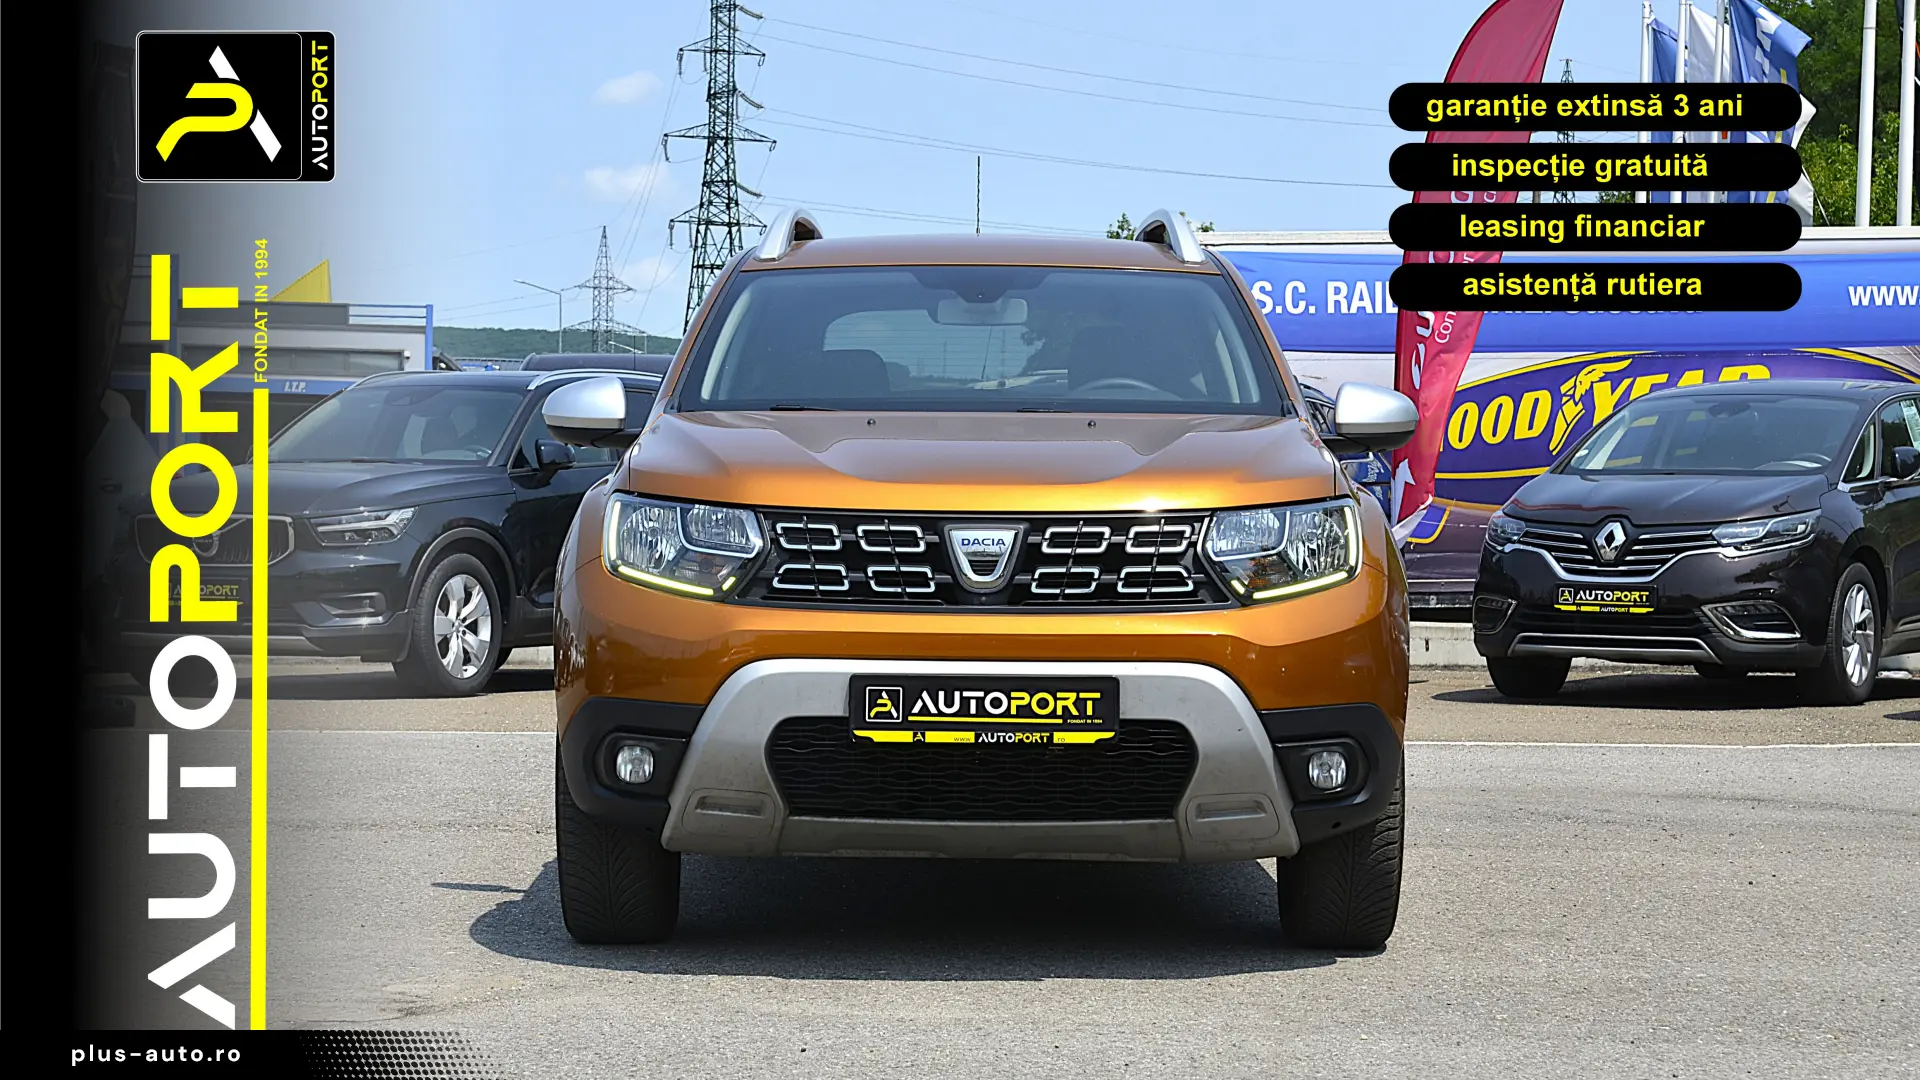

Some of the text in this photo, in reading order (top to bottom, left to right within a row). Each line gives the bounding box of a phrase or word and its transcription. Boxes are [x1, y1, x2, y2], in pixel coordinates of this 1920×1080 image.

[1250, 280, 1316, 314] S.C.
[961, 538, 1006, 547] DACIA
[1576, 590, 1649, 602] AUTOPORT
[910, 690, 1101, 716] AUTOPORT
[978, 732, 1050, 743] AUTOPORT
